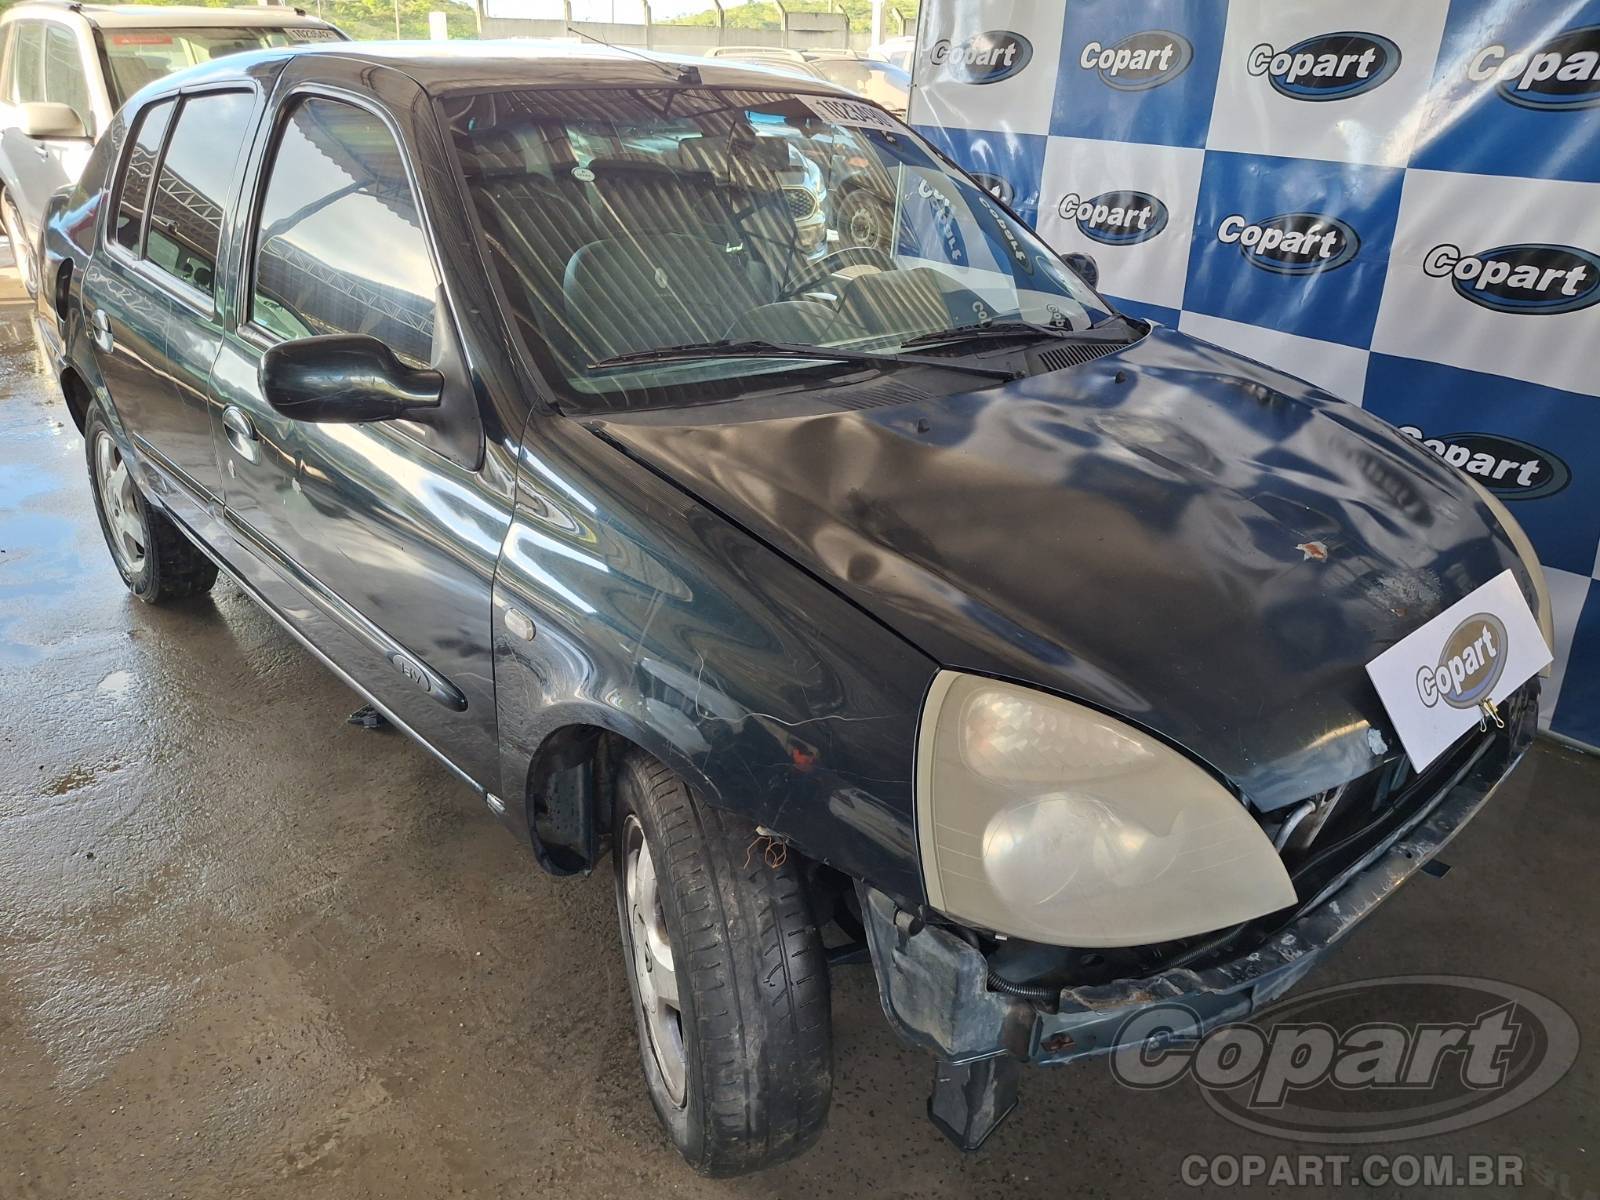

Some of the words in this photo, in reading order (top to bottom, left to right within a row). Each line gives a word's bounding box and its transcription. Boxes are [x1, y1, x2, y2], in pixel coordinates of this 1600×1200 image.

[931, 40, 1016, 70] Copart
[1081, 41, 1174, 76] Copart
[1247, 43, 1376, 84] Copart
[1467, 45, 1600, 90] Copa
[1059, 193, 1151, 230] Copart
[1218, 215, 1337, 259] Copart
[1424, 244, 1588, 297] Copart
[1417, 624, 1497, 708] Copart
